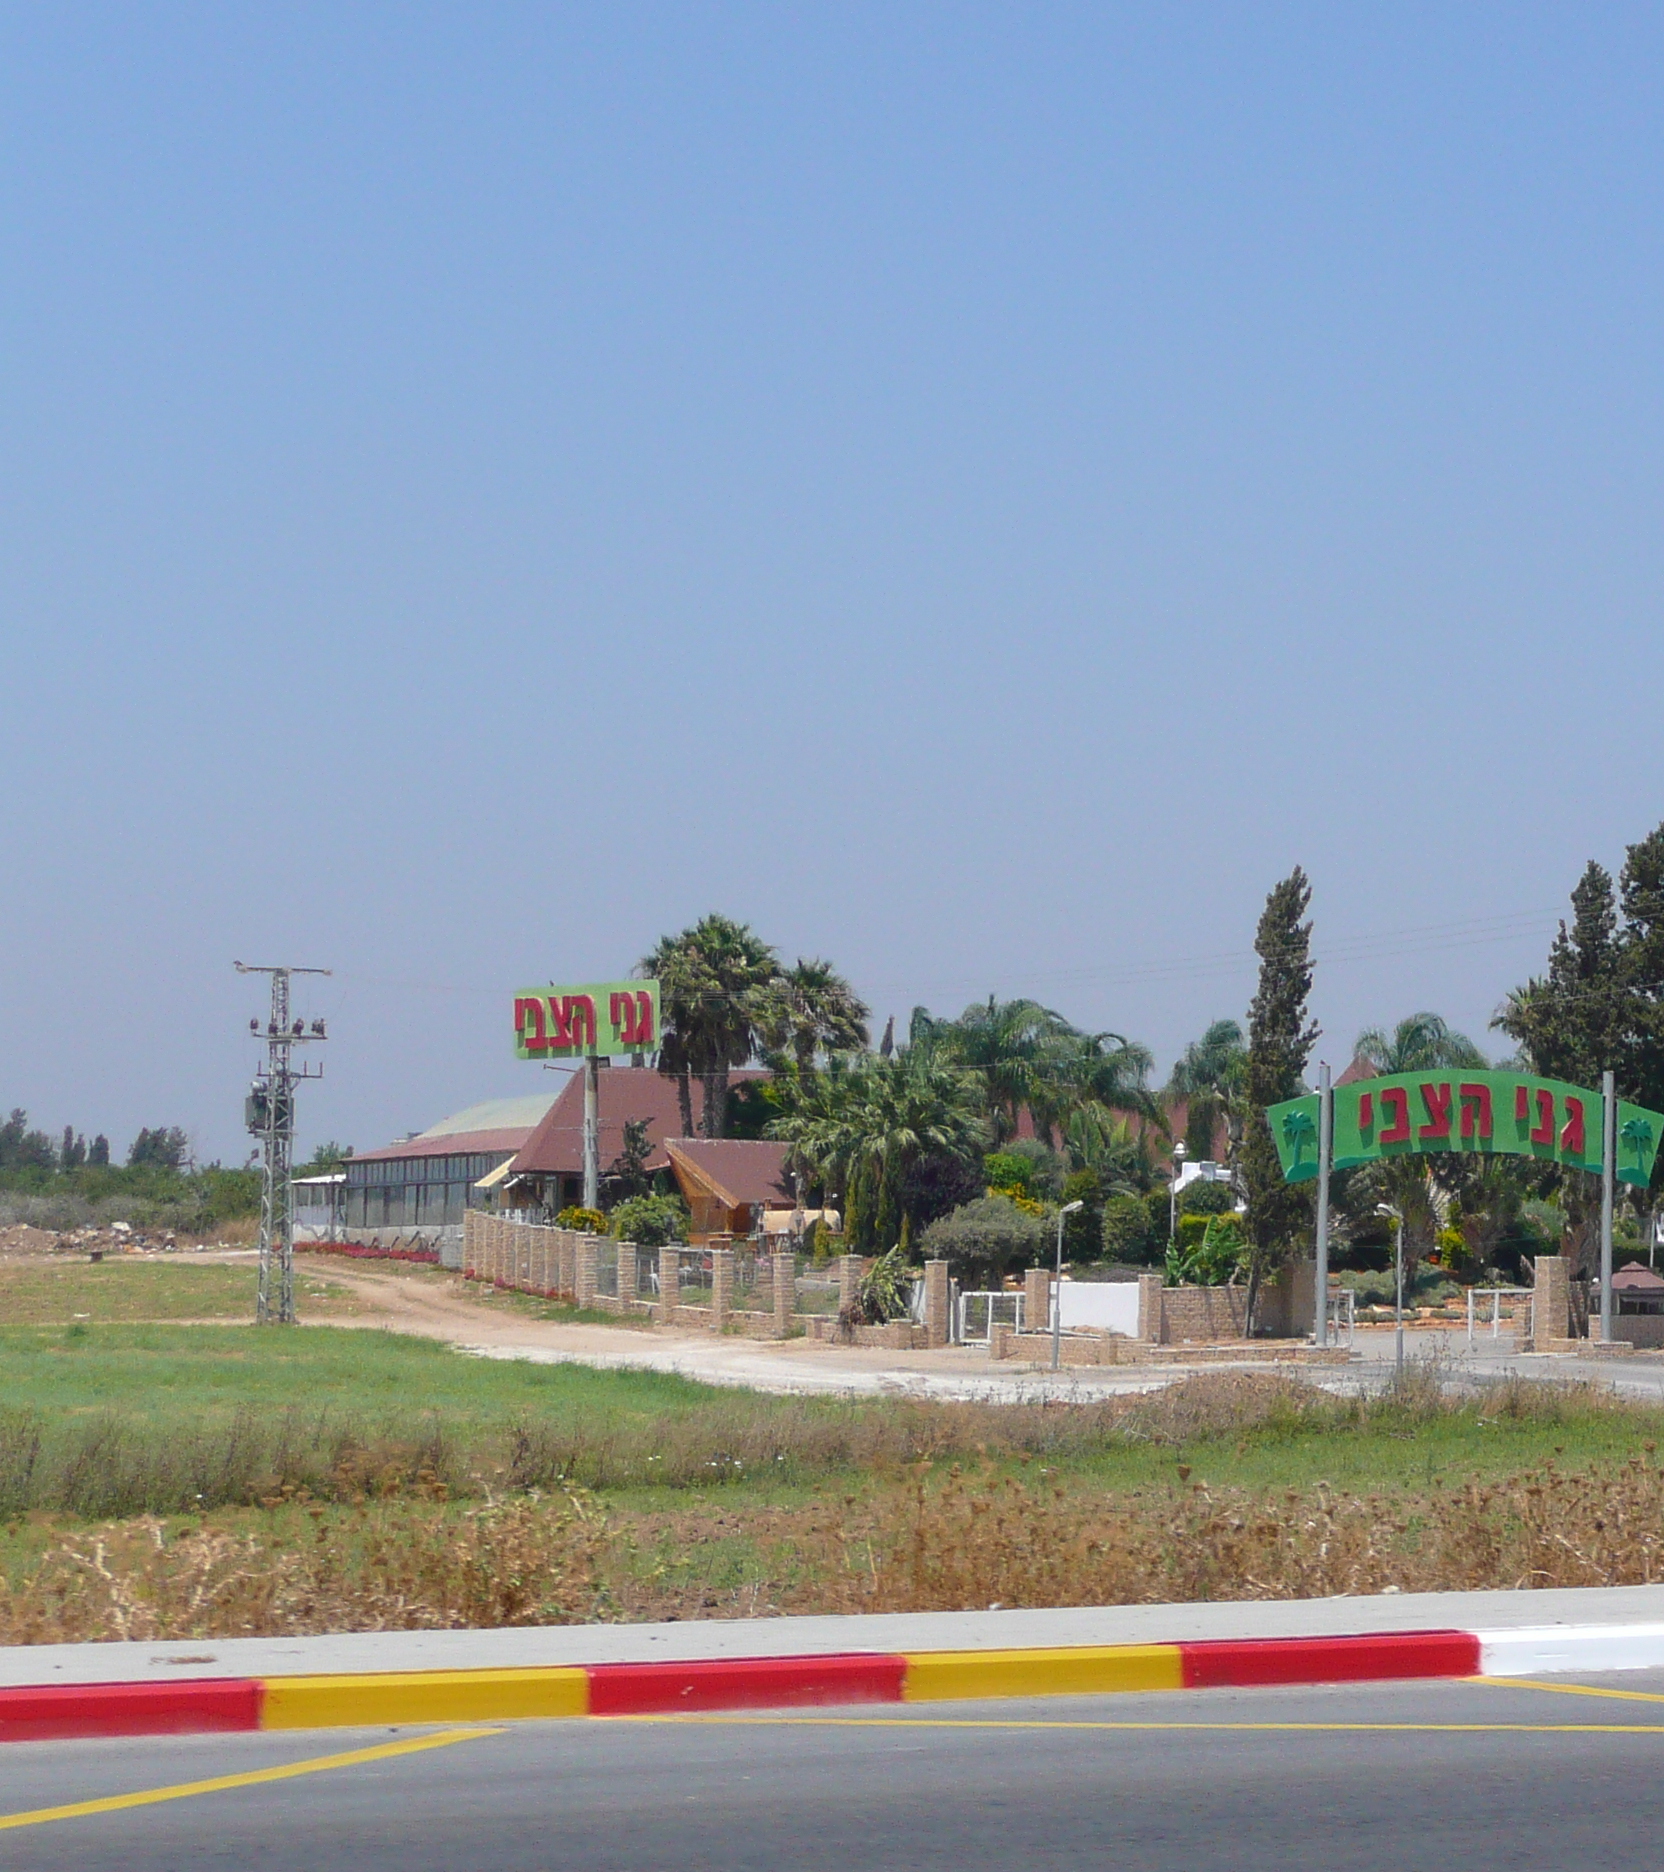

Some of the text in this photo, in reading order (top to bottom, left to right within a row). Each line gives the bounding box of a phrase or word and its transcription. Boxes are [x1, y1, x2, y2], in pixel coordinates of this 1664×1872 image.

[514, 992, 653, 1050] גני הצבי
[1358, 1083, 1585, 1153] גני הצבי
